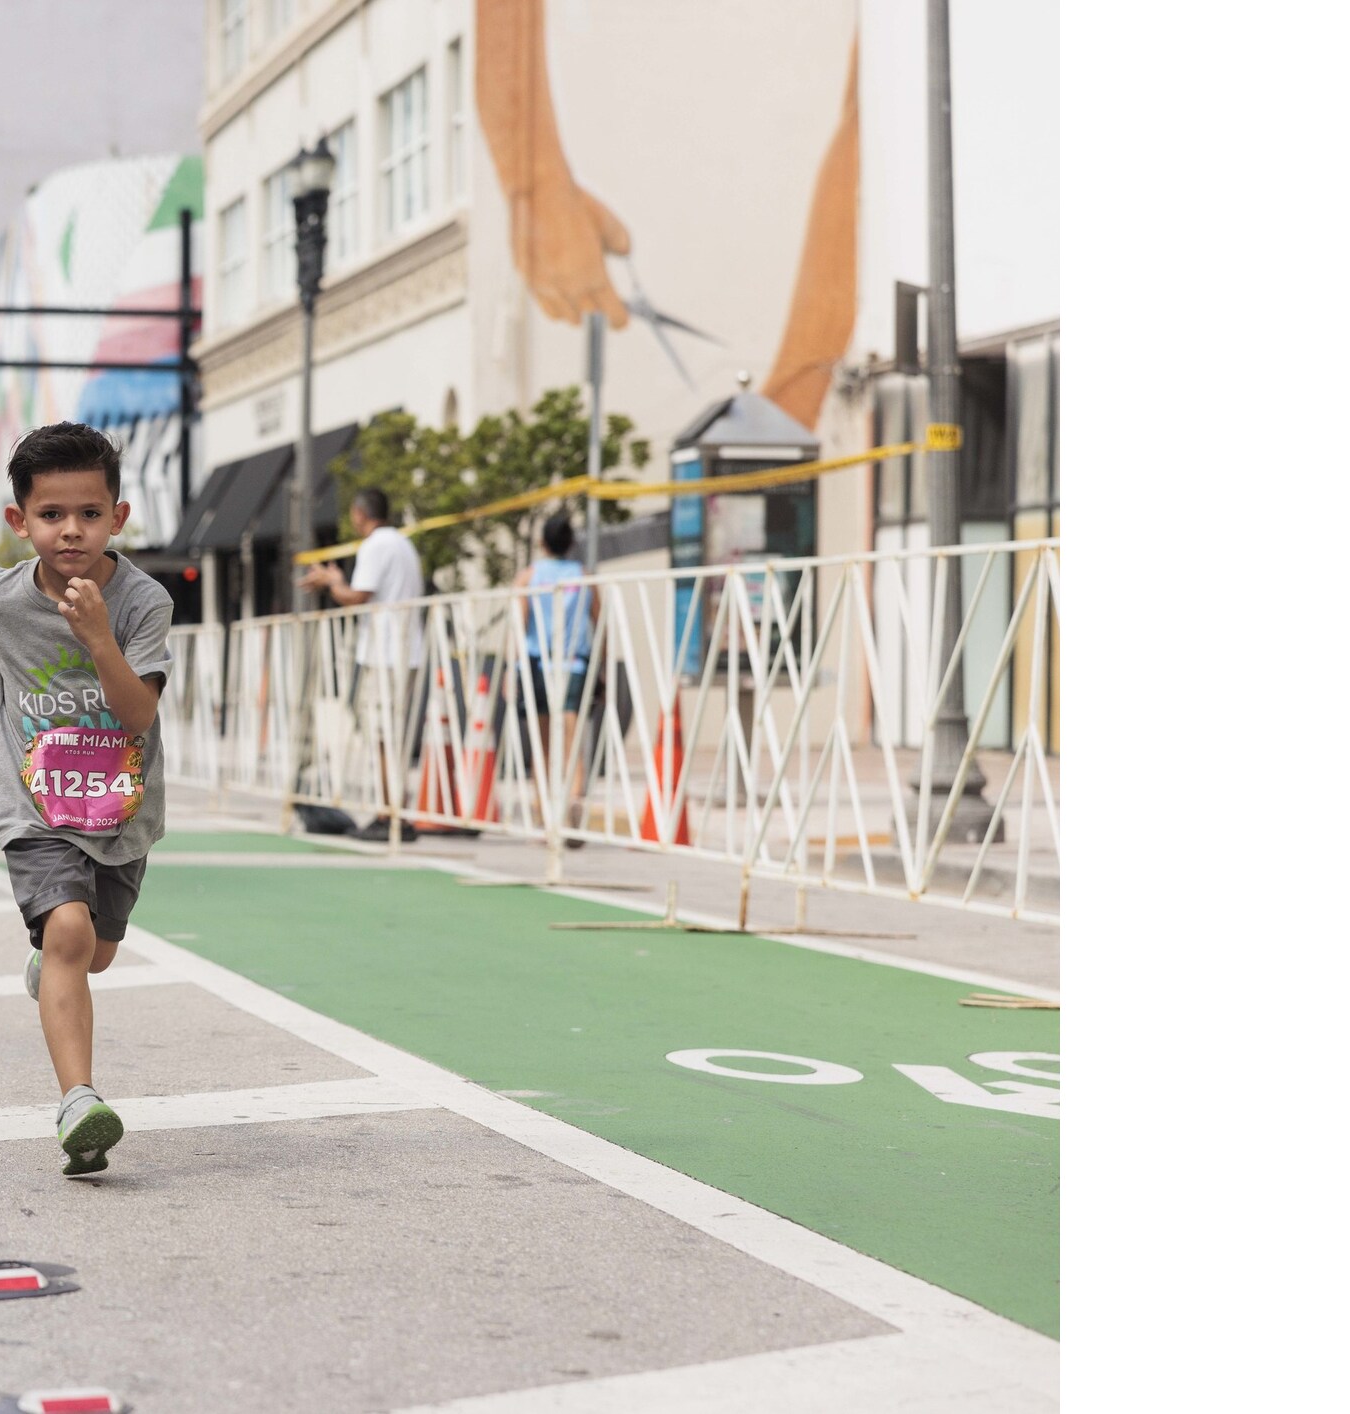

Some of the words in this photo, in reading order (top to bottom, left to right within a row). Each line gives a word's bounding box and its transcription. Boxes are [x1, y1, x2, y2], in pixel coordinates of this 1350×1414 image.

[19, 690, 77, 716] KIDS
[82, 687, 111, 711] RU
[53, 733, 81, 746] TIME
[82, 734, 128, 748] MIAMI
[30, 768, 136, 798] 41254
[52, 813, 85, 824] JANUARY
[96, 818, 118, 827] 2024
